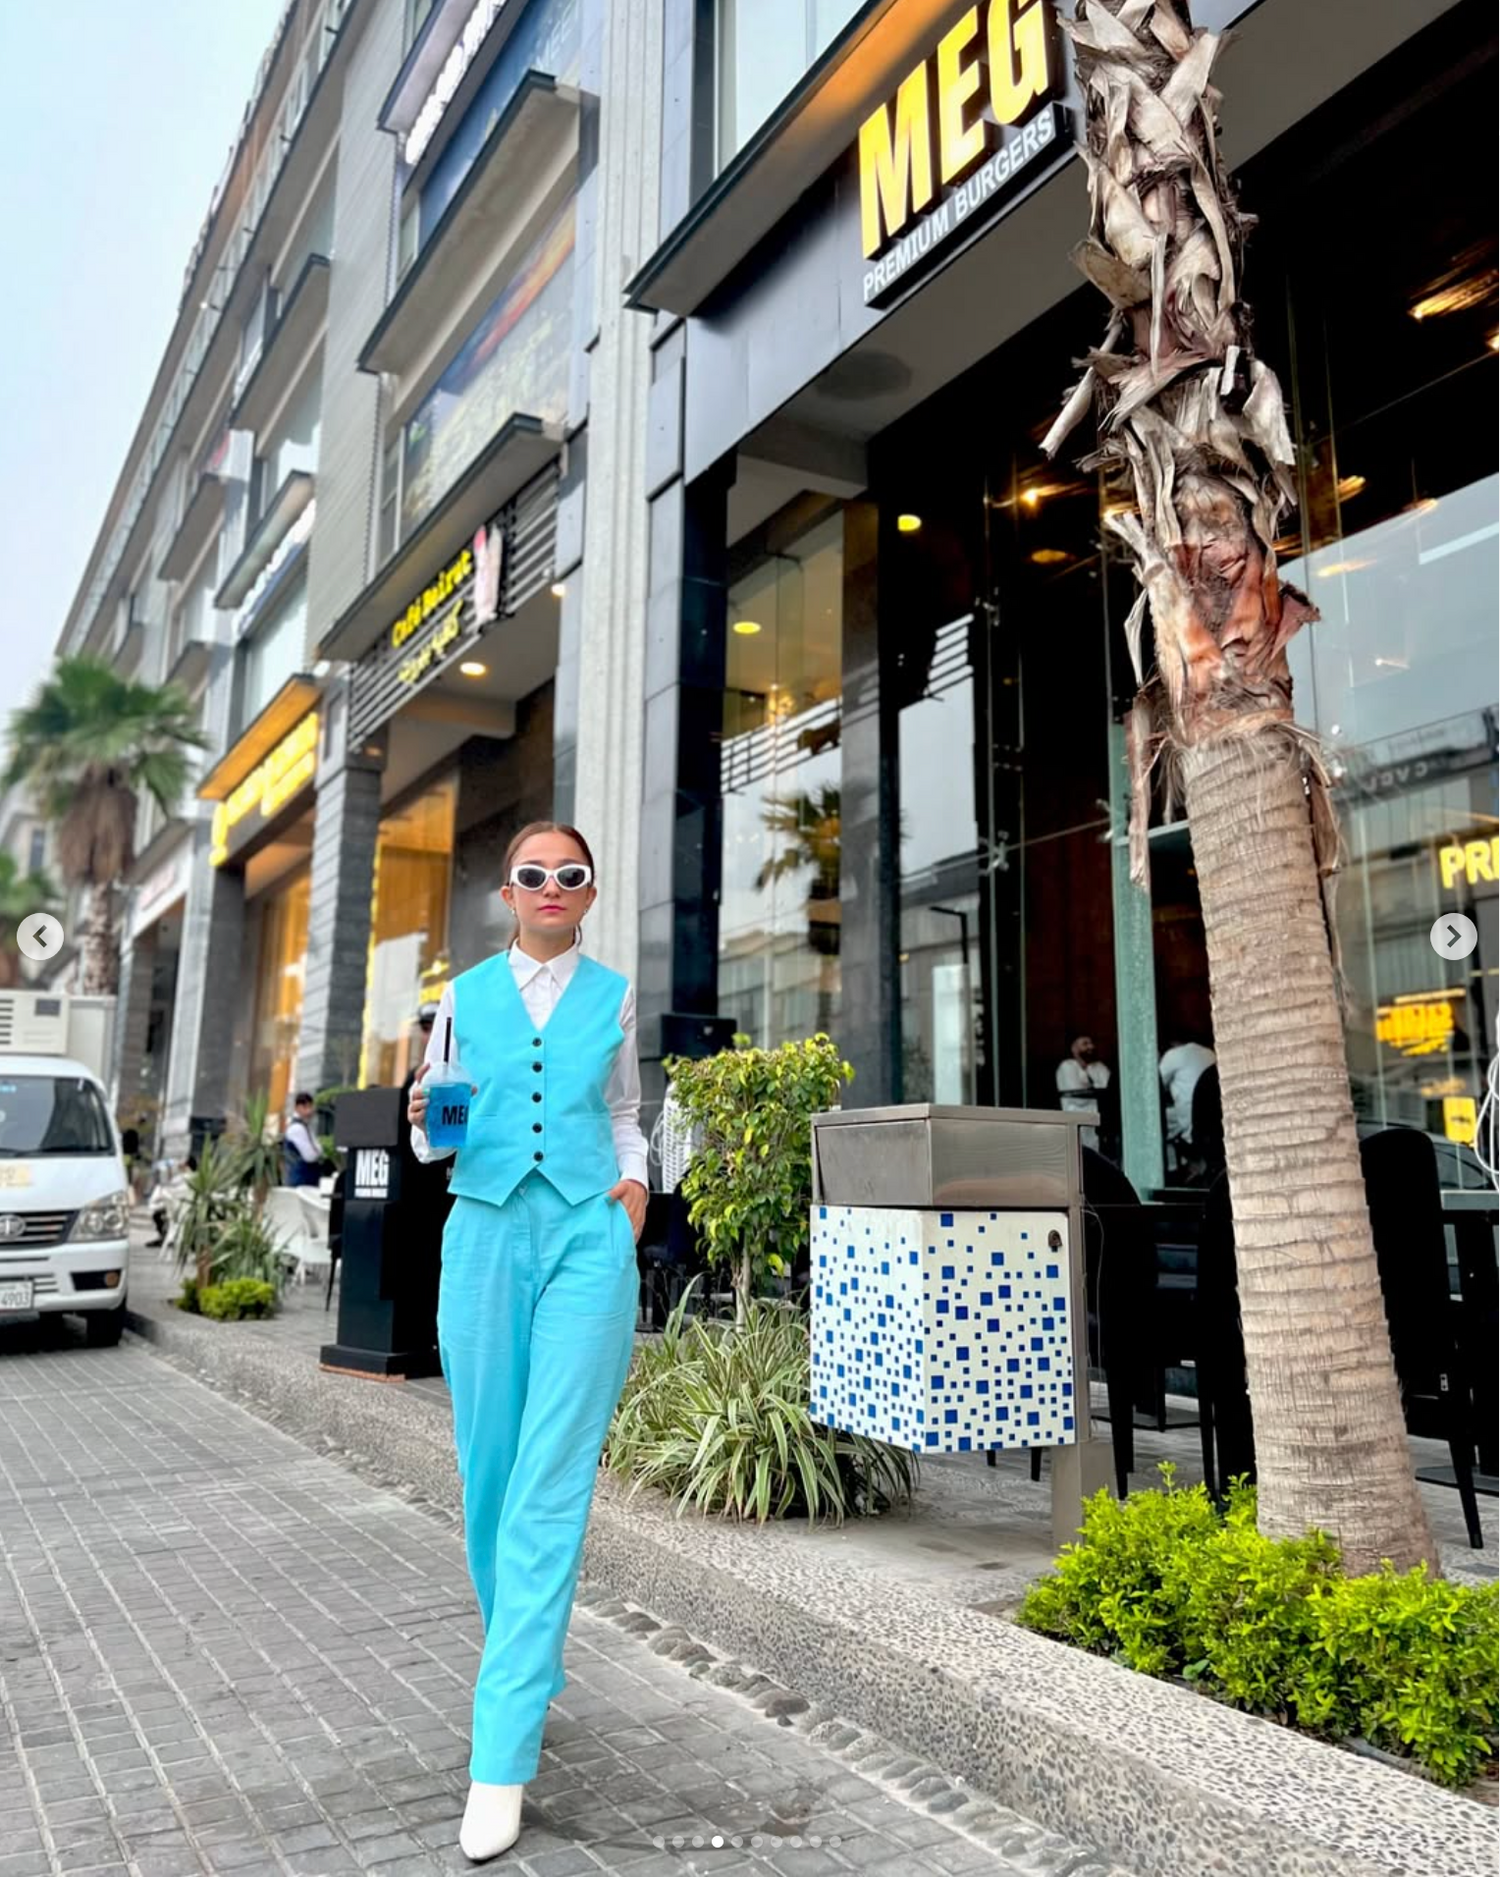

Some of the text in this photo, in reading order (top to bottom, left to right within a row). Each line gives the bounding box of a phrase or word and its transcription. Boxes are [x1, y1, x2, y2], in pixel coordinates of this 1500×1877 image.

[859, 0, 1049, 260] MEG
[863, 109, 1052, 301] PREMIUM BURGERS
[355, 1149, 390, 1186] MEG
